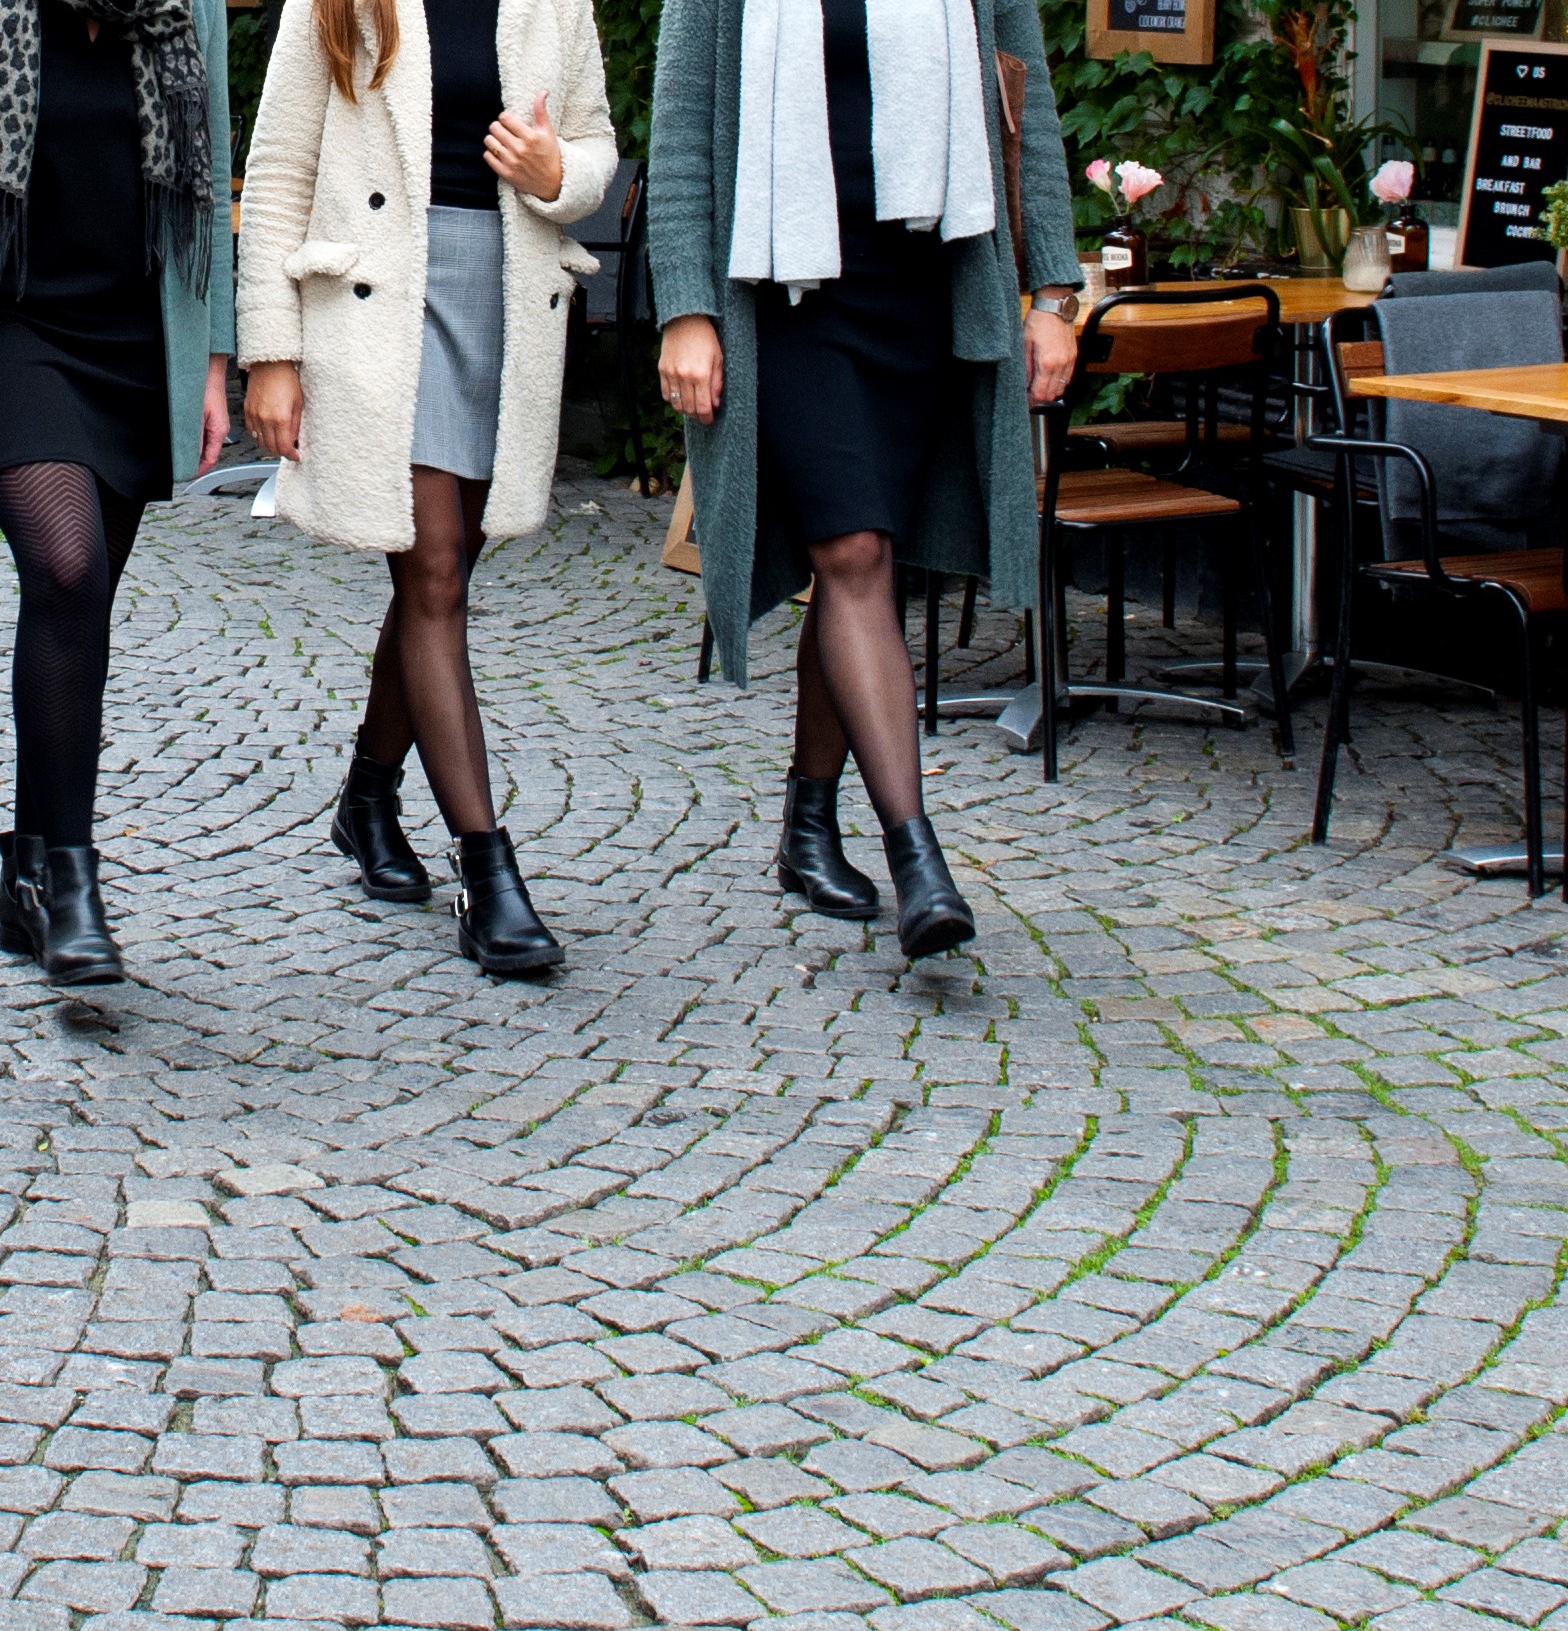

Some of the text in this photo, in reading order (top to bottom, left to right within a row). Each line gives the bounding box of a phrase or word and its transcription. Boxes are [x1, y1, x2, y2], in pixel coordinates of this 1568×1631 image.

[1500, 125, 1554, 140] STREETFOOD
[1501, 155, 1542, 169] AND BAR
[1476, 178, 1526, 194] BREAKFAST
[1493, 201, 1531, 216] BRUNCH
